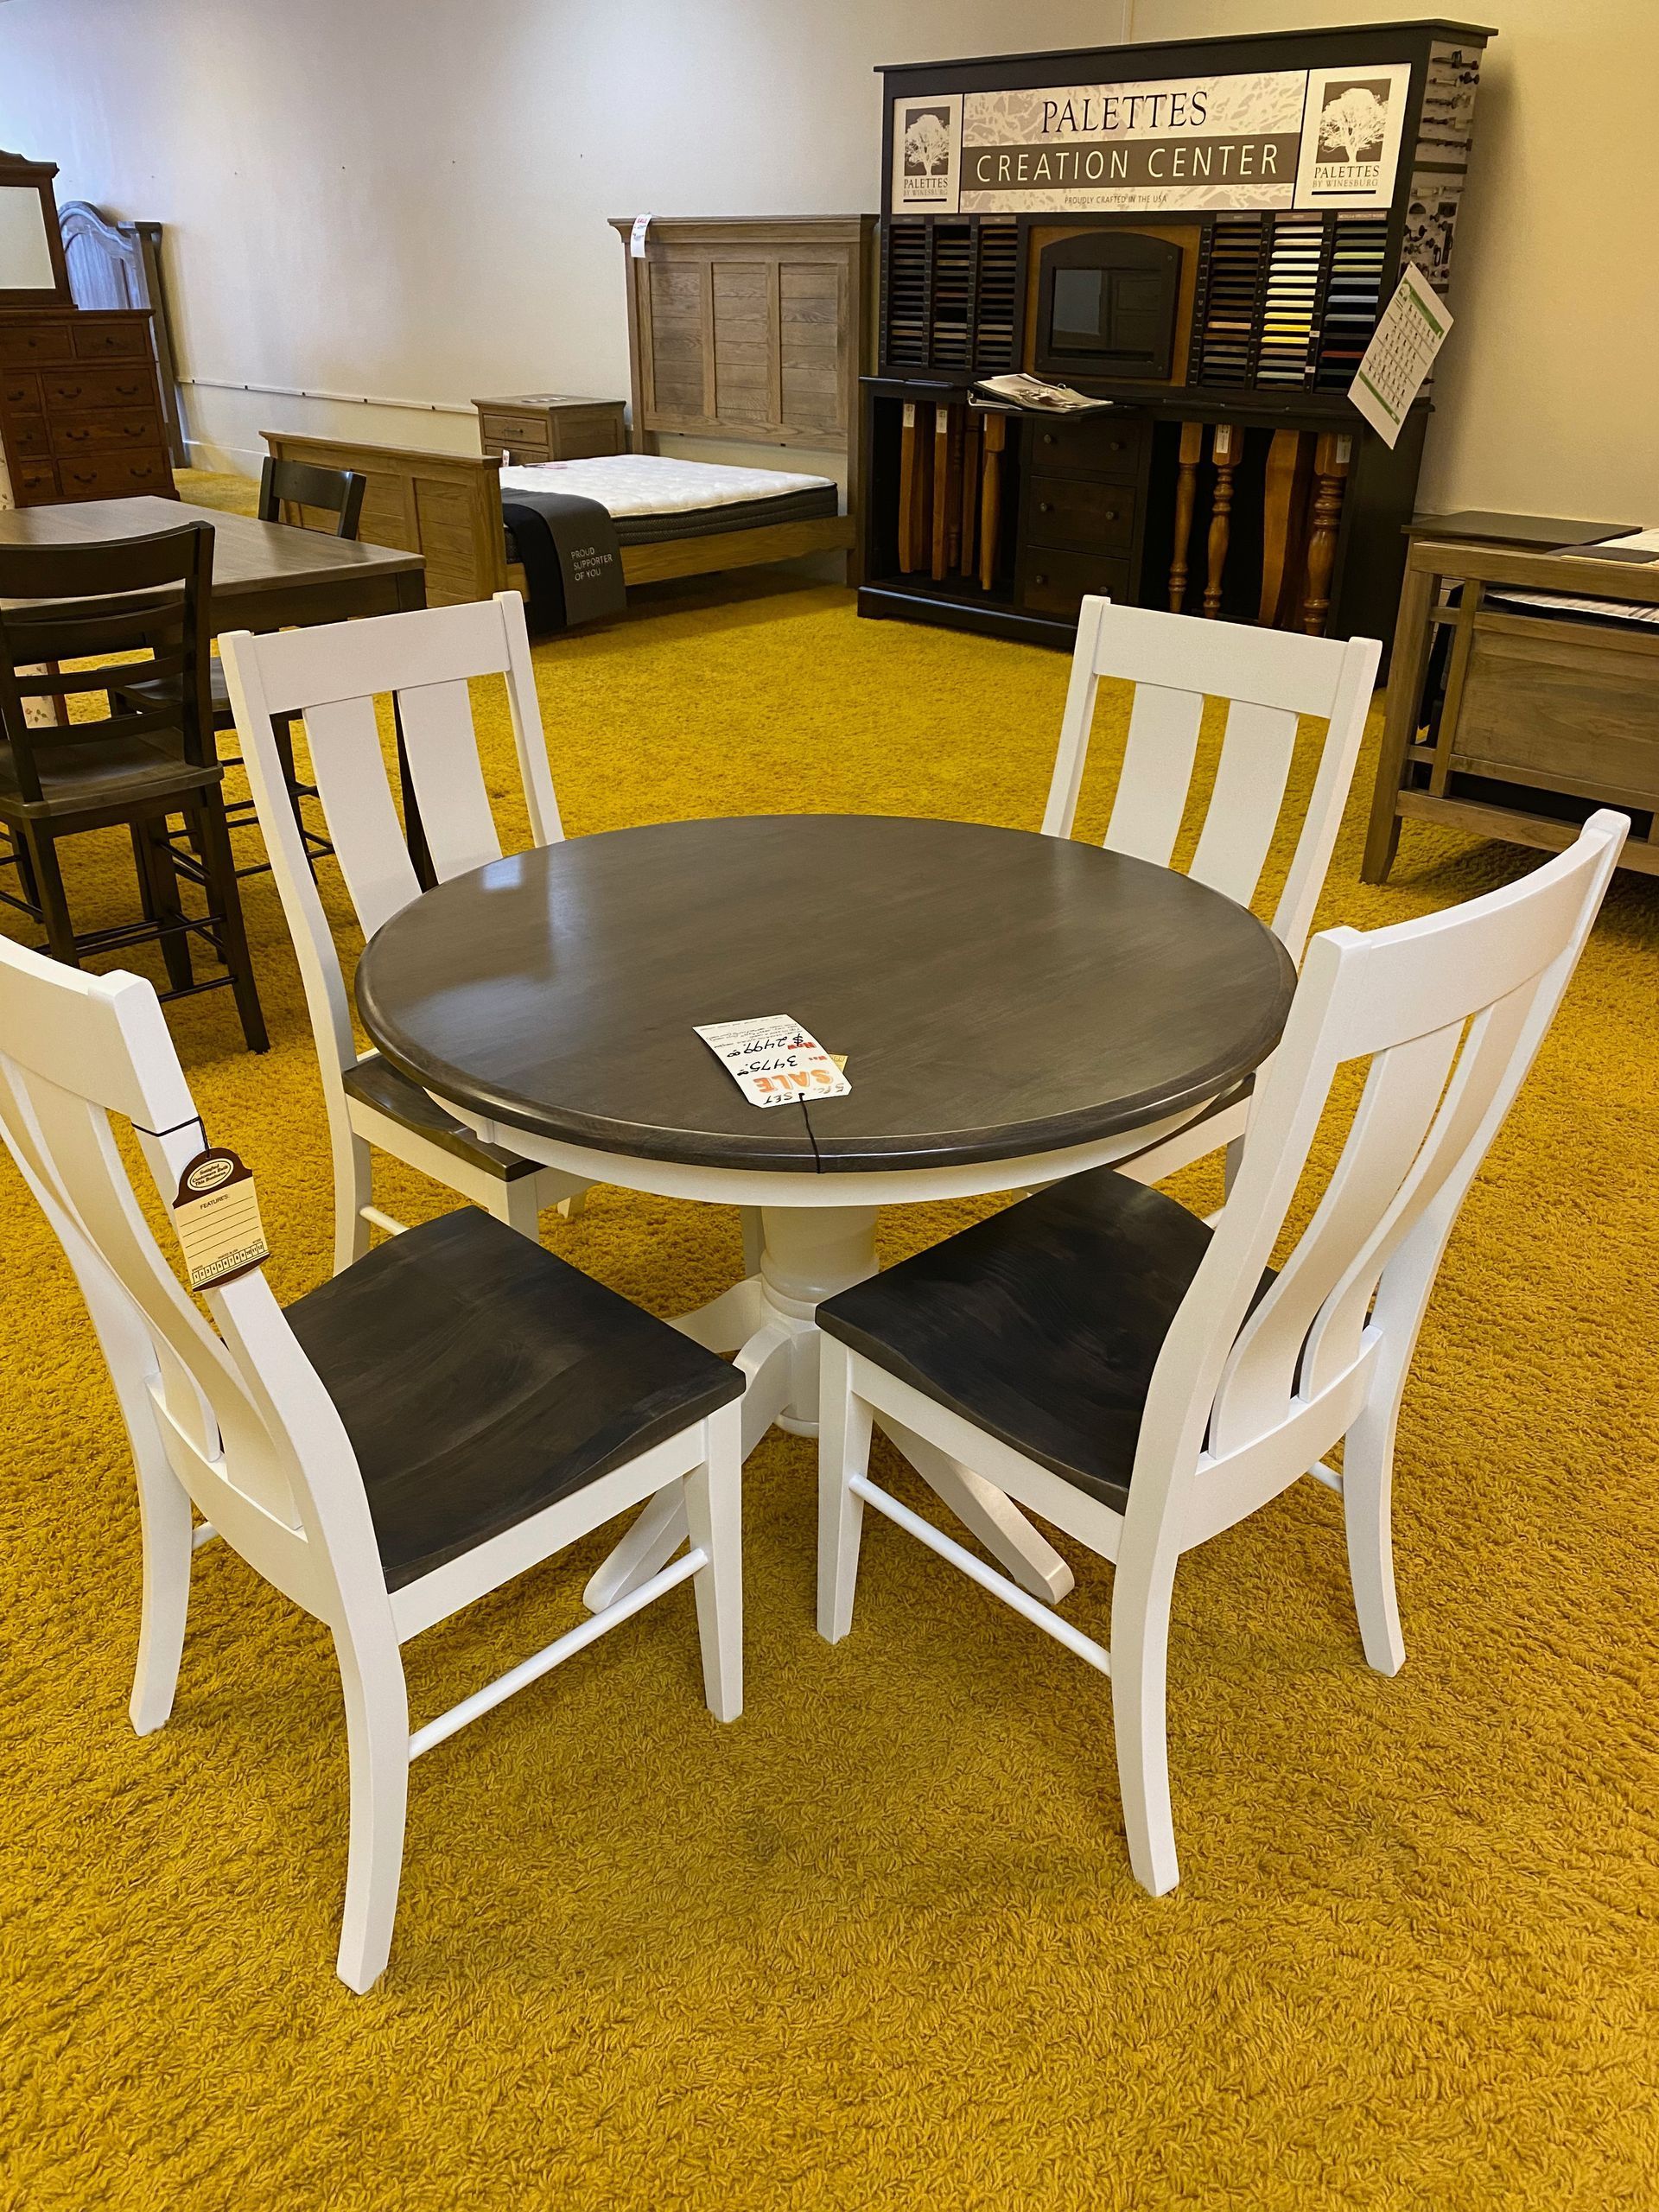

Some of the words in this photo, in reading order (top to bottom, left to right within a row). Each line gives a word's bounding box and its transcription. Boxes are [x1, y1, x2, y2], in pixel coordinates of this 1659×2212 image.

[1041, 91, 1207, 133] PALETTES
[976, 149, 1128, 182] CREATION
[1147, 143, 1278, 178] CENTER
[1313, 165, 1380, 179] PALETTES
[904, 177, 949, 188] PALETTES
[1313, 180, 1323, 188] BY
[1326, 178, 1378, 188] WINESBURG
[1096, 195, 1126, 204] CRAFTED
[1138, 194, 1150, 203] THE
[1153, 194, 1167, 203] USA
[570, 547, 595, 559] PROUD
[573, 554, 613, 570] SUPPORTER
[575, 572, 585, 581] OF
[586, 568, 601, 578] YOU
[753, 1069, 834, 1093] SALE
[763, 1091, 794, 1105] SET
